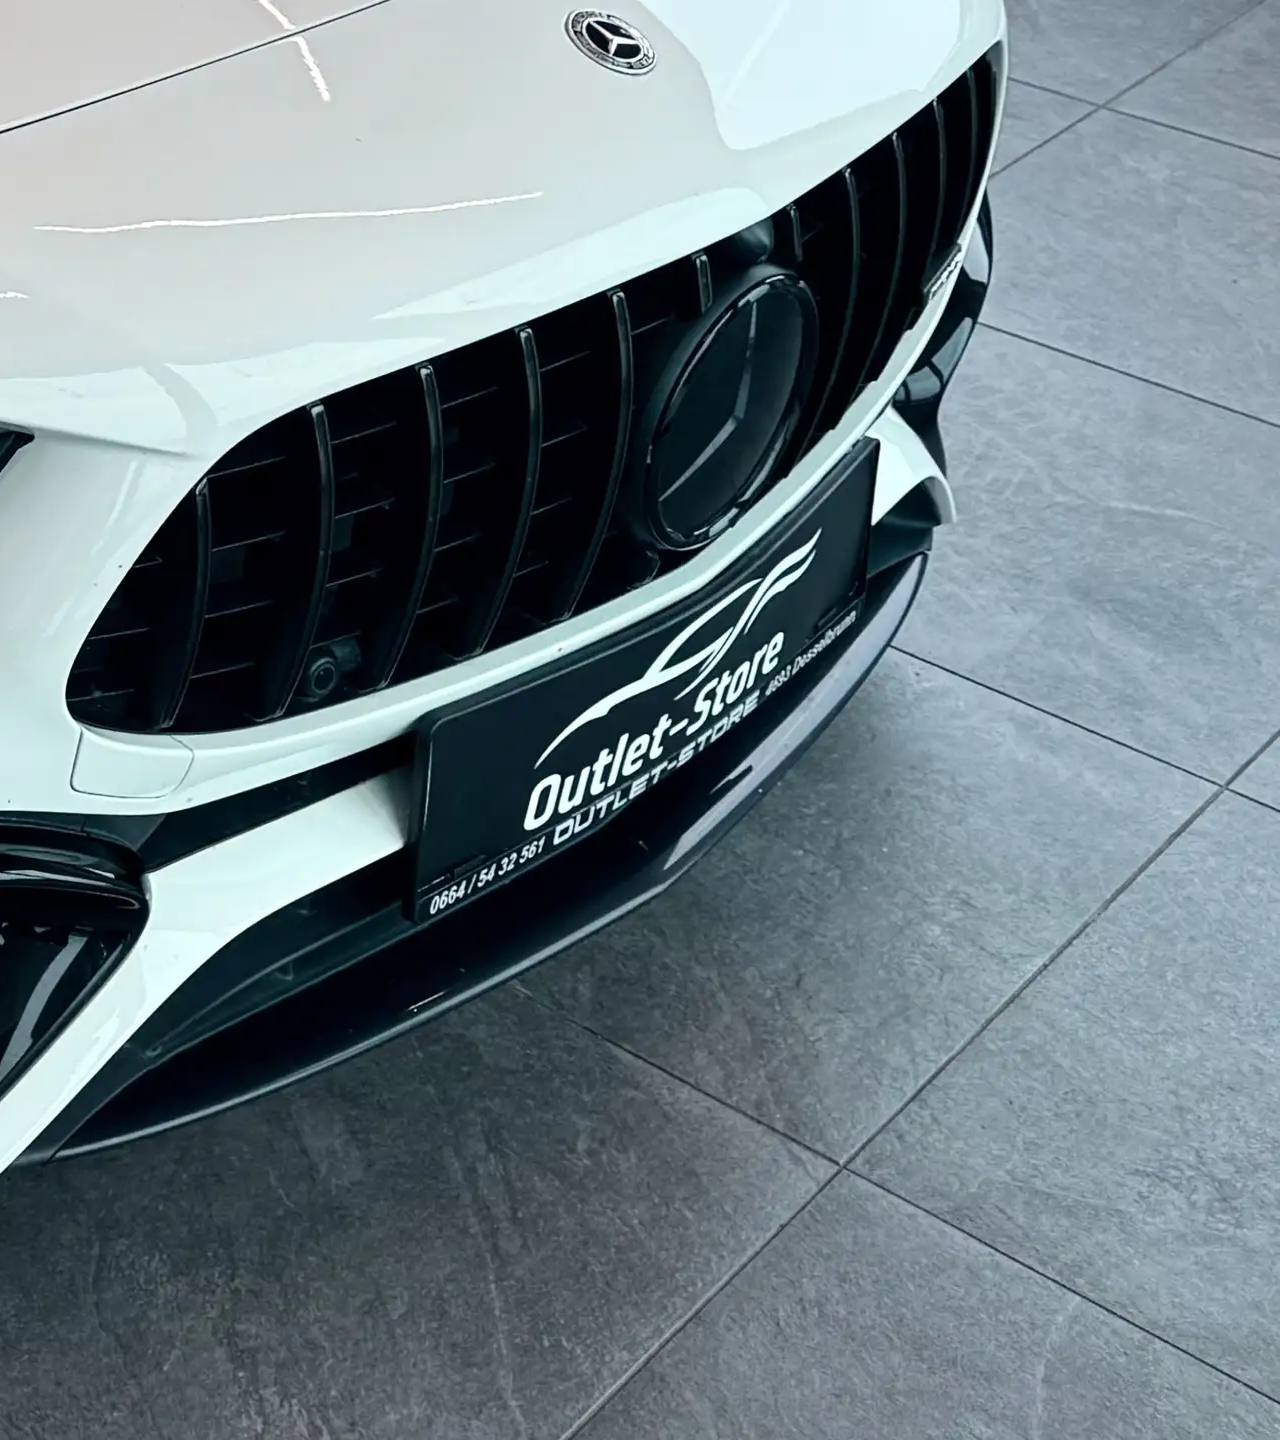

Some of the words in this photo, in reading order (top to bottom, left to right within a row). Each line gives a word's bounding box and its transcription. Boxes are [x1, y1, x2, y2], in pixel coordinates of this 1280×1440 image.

[429, 880, 467, 915] 0664
[477, 863, 497, 888] 54
[498, 852, 519, 876] 32
[519, 835, 546, 864] 561
[553, 689, 761, 846] OUTLET-STORE
[523, 631, 785, 831] Outlet-Store
